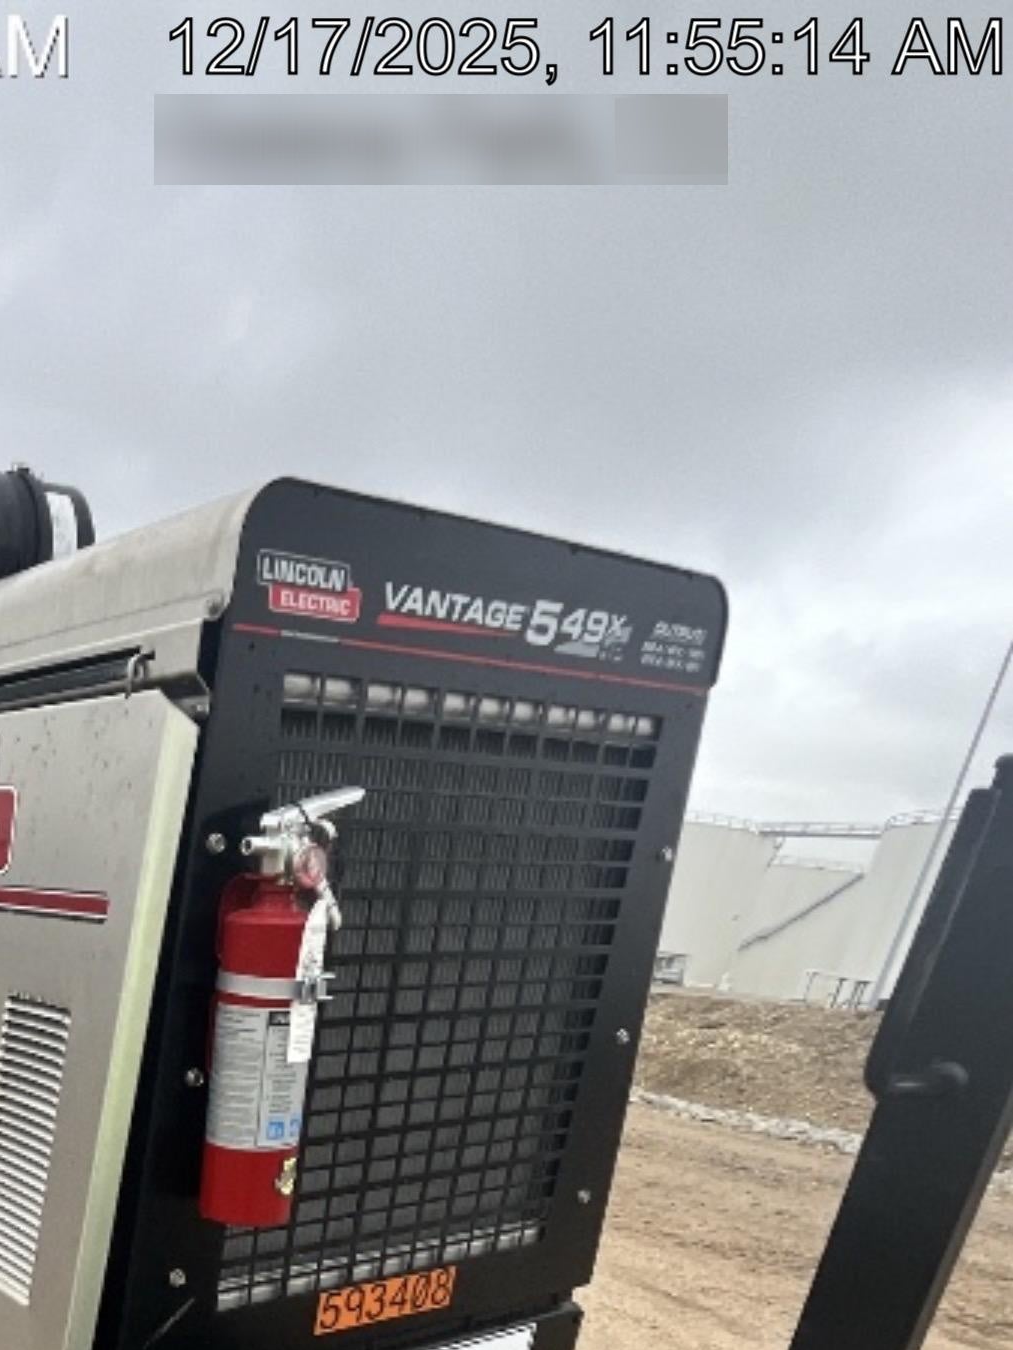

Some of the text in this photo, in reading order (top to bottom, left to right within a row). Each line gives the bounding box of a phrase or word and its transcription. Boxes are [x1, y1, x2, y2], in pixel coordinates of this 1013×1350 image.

[262, 556, 345, 592] LINCOLN
[279, 590, 352, 616] ELECTRIC
[385, 581, 528, 630] VANTAGE
[320, 1268, 453, 1330] 593408
